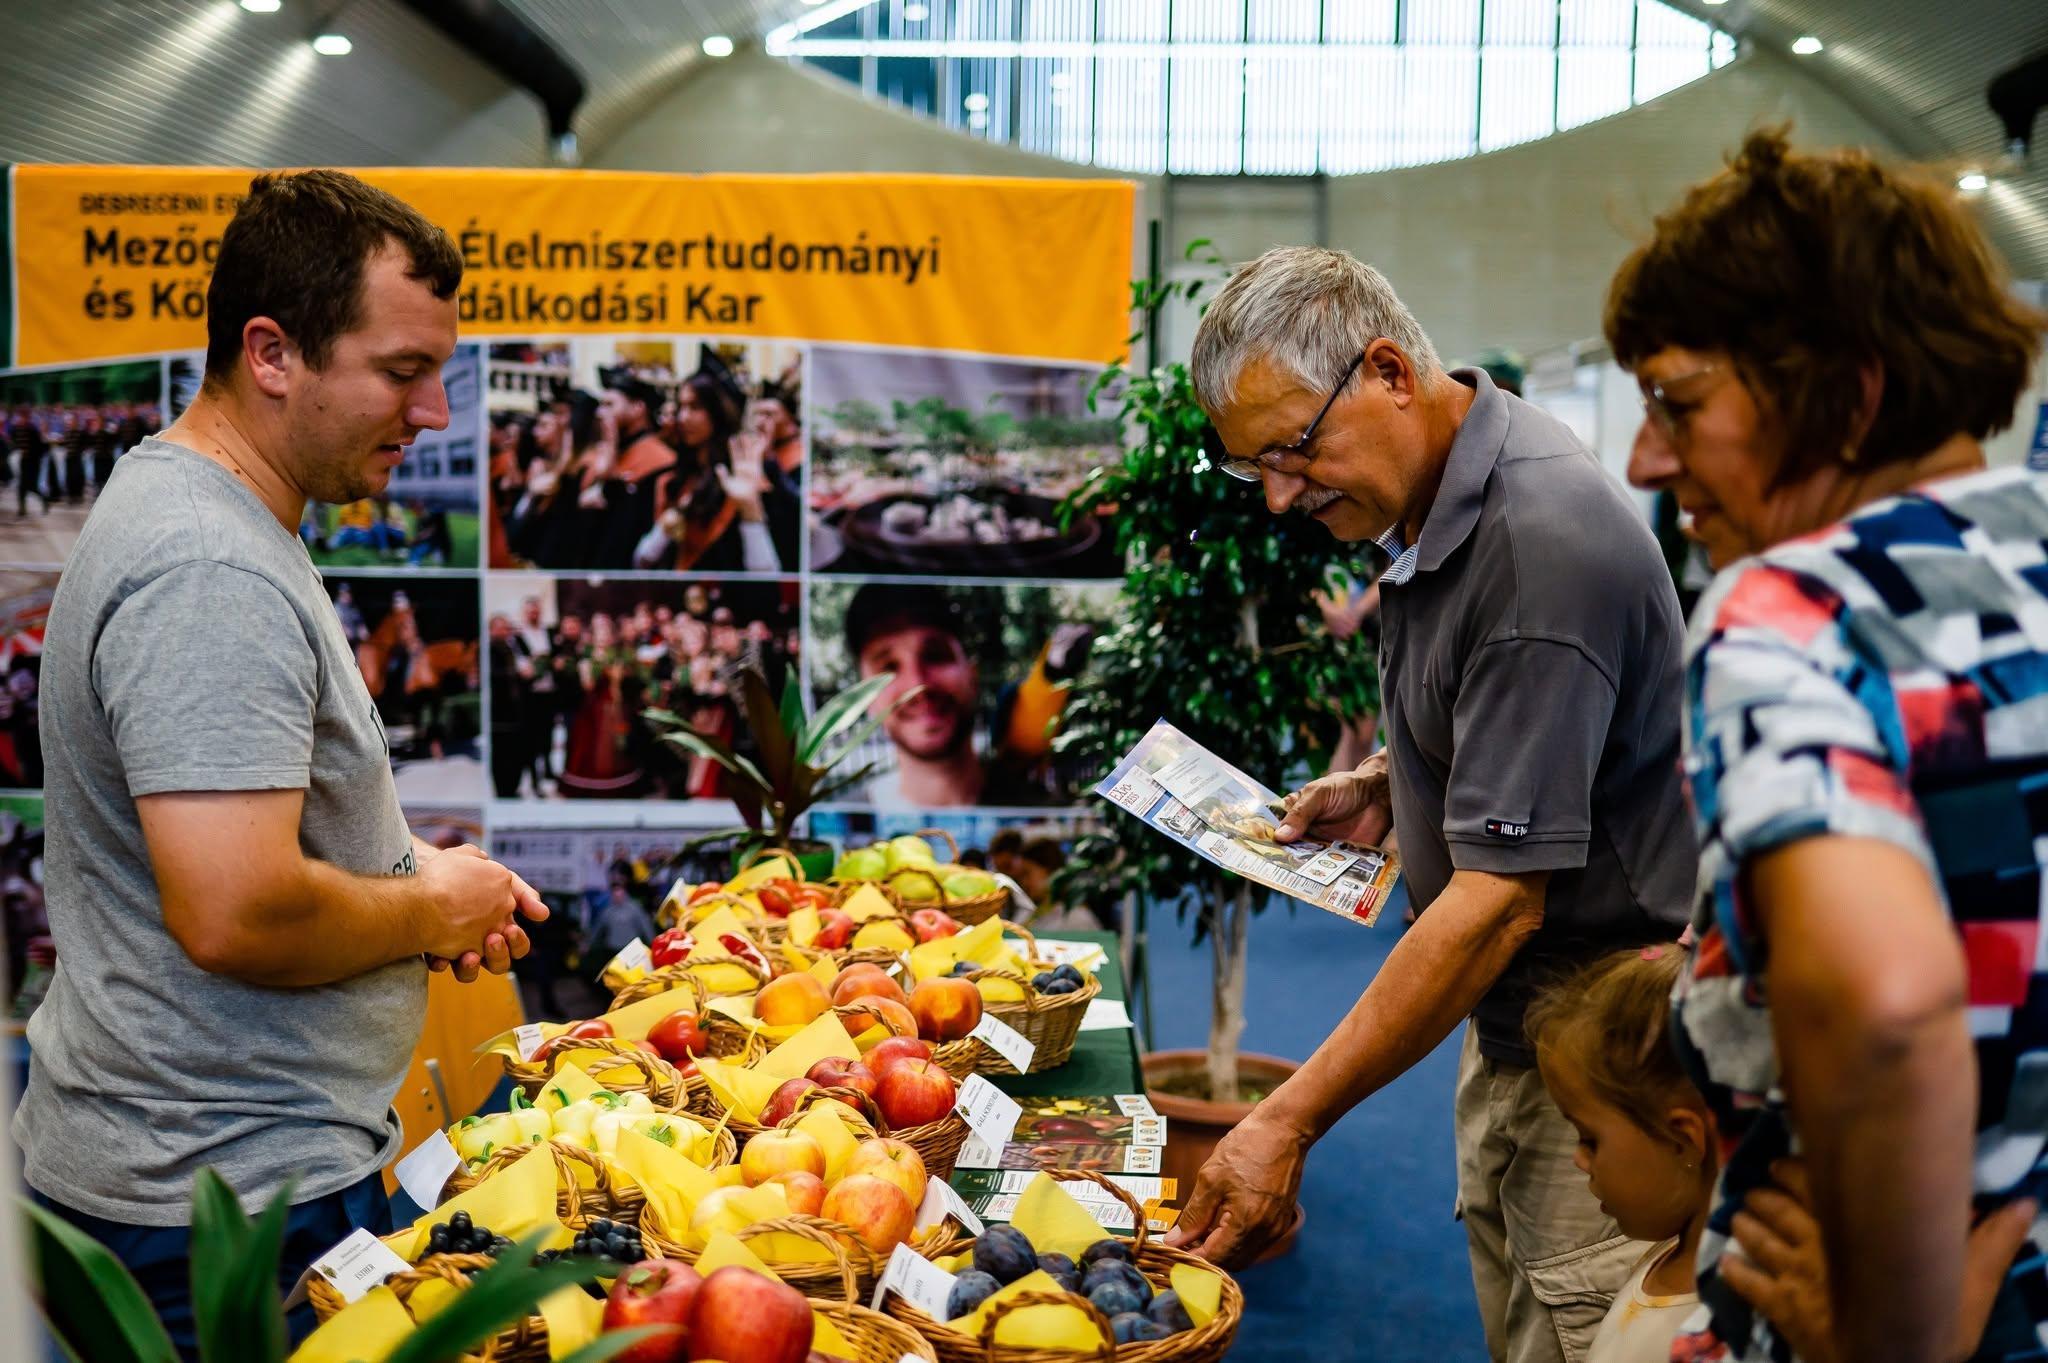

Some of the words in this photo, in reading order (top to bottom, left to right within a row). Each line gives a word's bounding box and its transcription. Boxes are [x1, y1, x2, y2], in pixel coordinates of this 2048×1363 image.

[80, 193, 208, 216] DEBRECENI
[460, 219, 940, 284] Élelmiszertudományi
[85, 278, 134, 320] és
[685, 285, 762, 324] Kar
